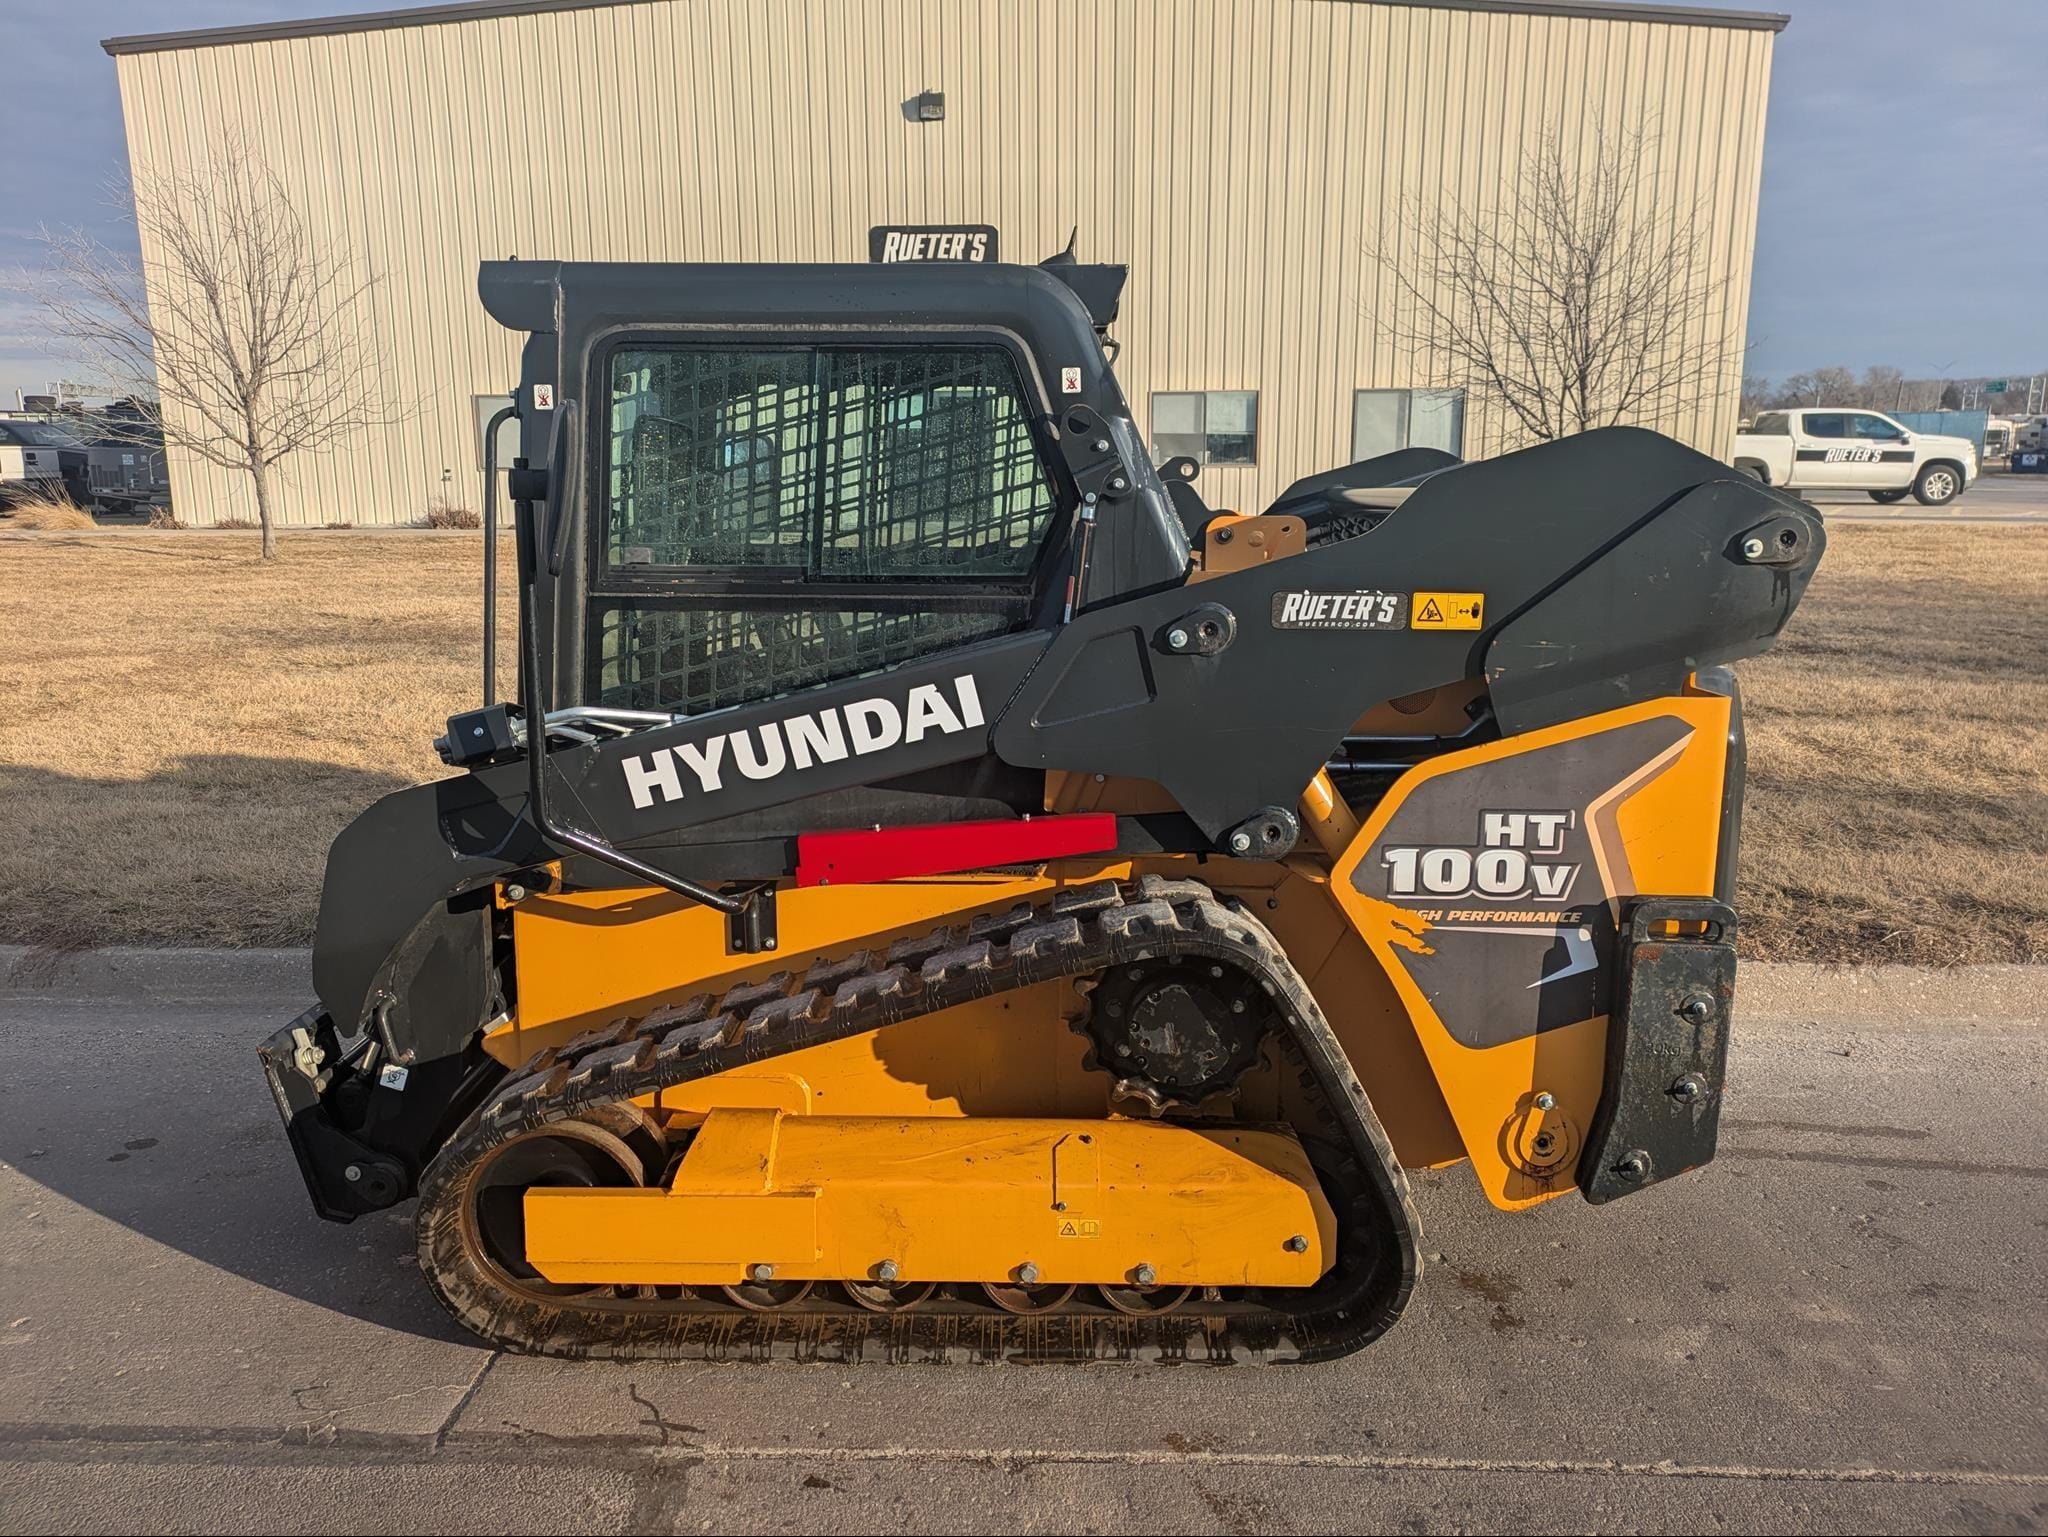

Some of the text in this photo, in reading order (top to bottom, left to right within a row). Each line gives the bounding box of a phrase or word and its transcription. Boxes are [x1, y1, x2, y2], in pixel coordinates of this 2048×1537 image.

[882, 232, 988, 264] RUETER'S
[1824, 448, 1883, 464] RUETER'S
[621, 674, 985, 810] HYUNDAI
[1485, 814, 1567, 847] HT
[1446, 910, 1582, 923] PERFORMANCE
